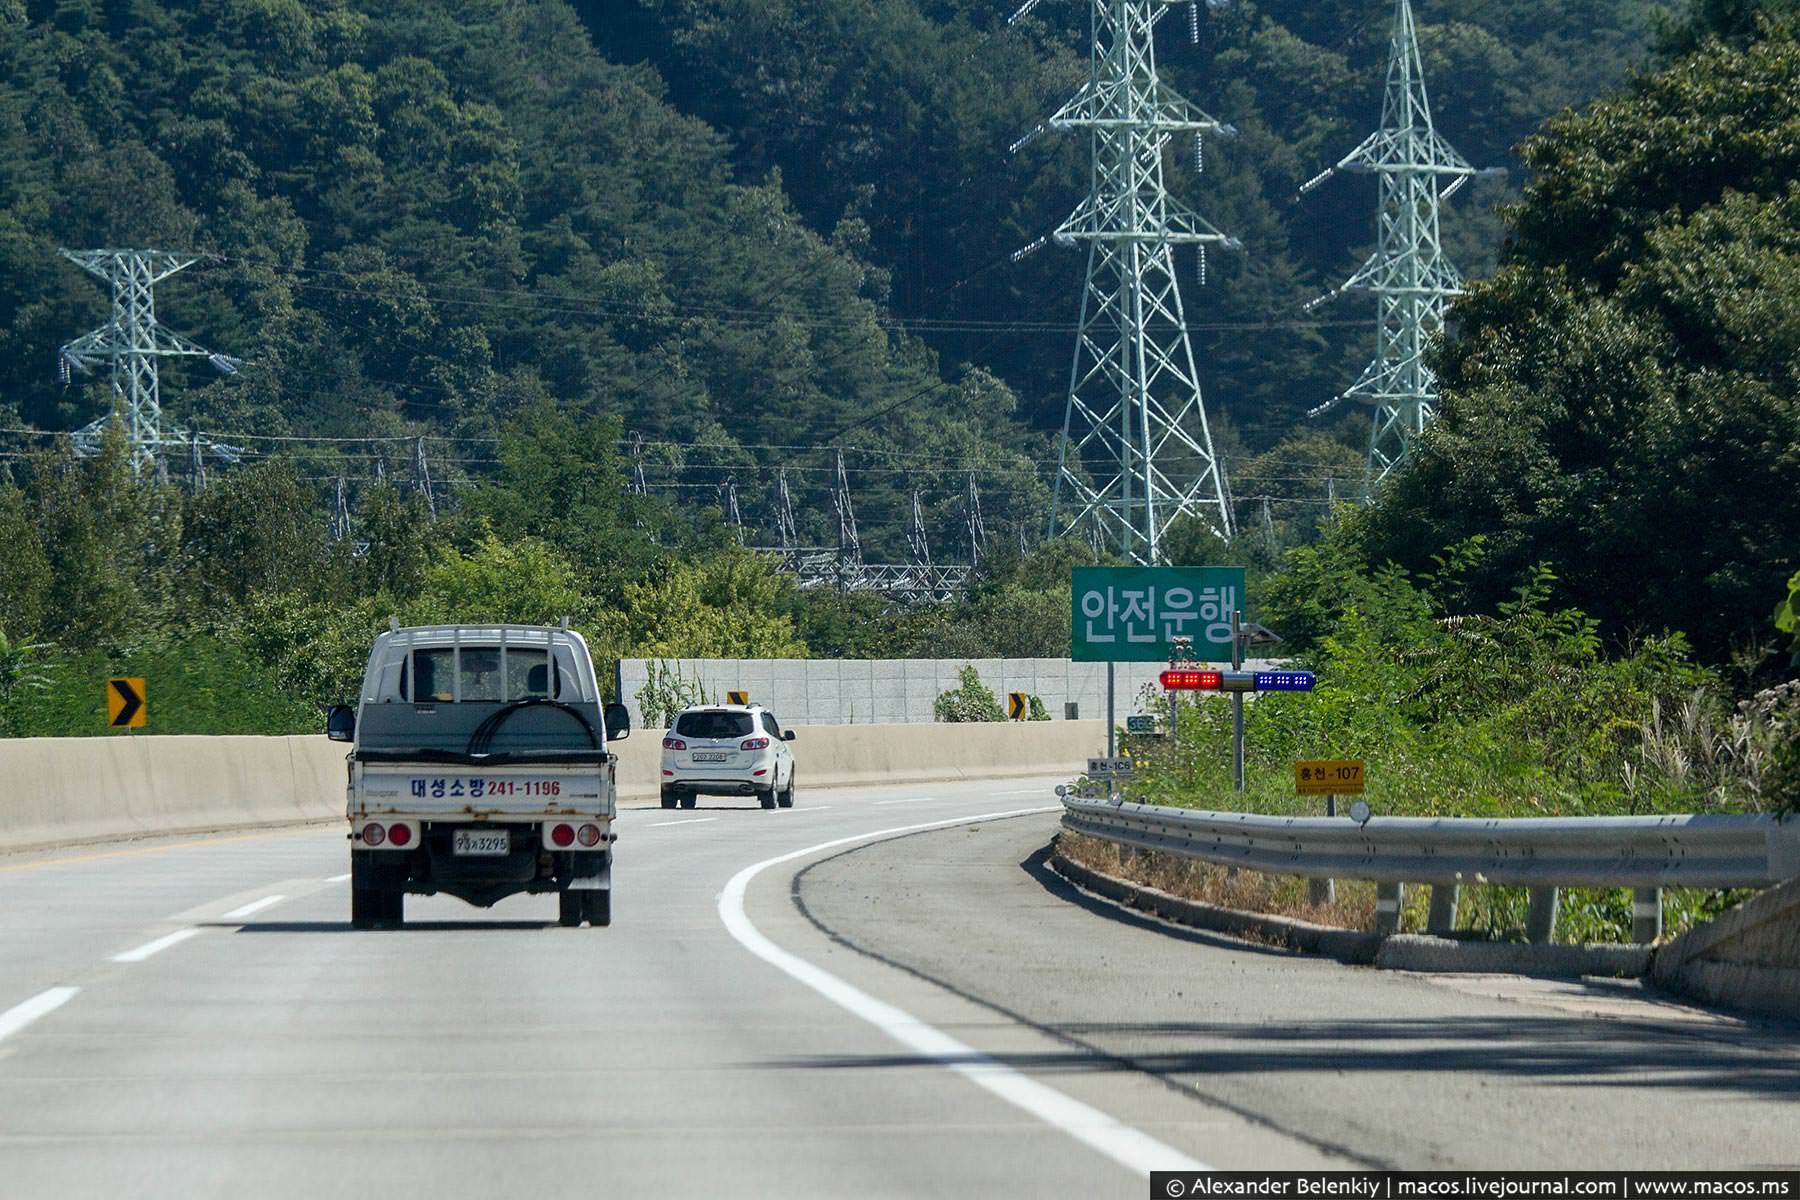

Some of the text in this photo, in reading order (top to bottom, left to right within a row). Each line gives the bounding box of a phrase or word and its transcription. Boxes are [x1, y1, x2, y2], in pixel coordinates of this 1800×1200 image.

[1081, 586, 1236, 643] 안전운행
[411, 778, 560, 798] 대성소방 241-1196
